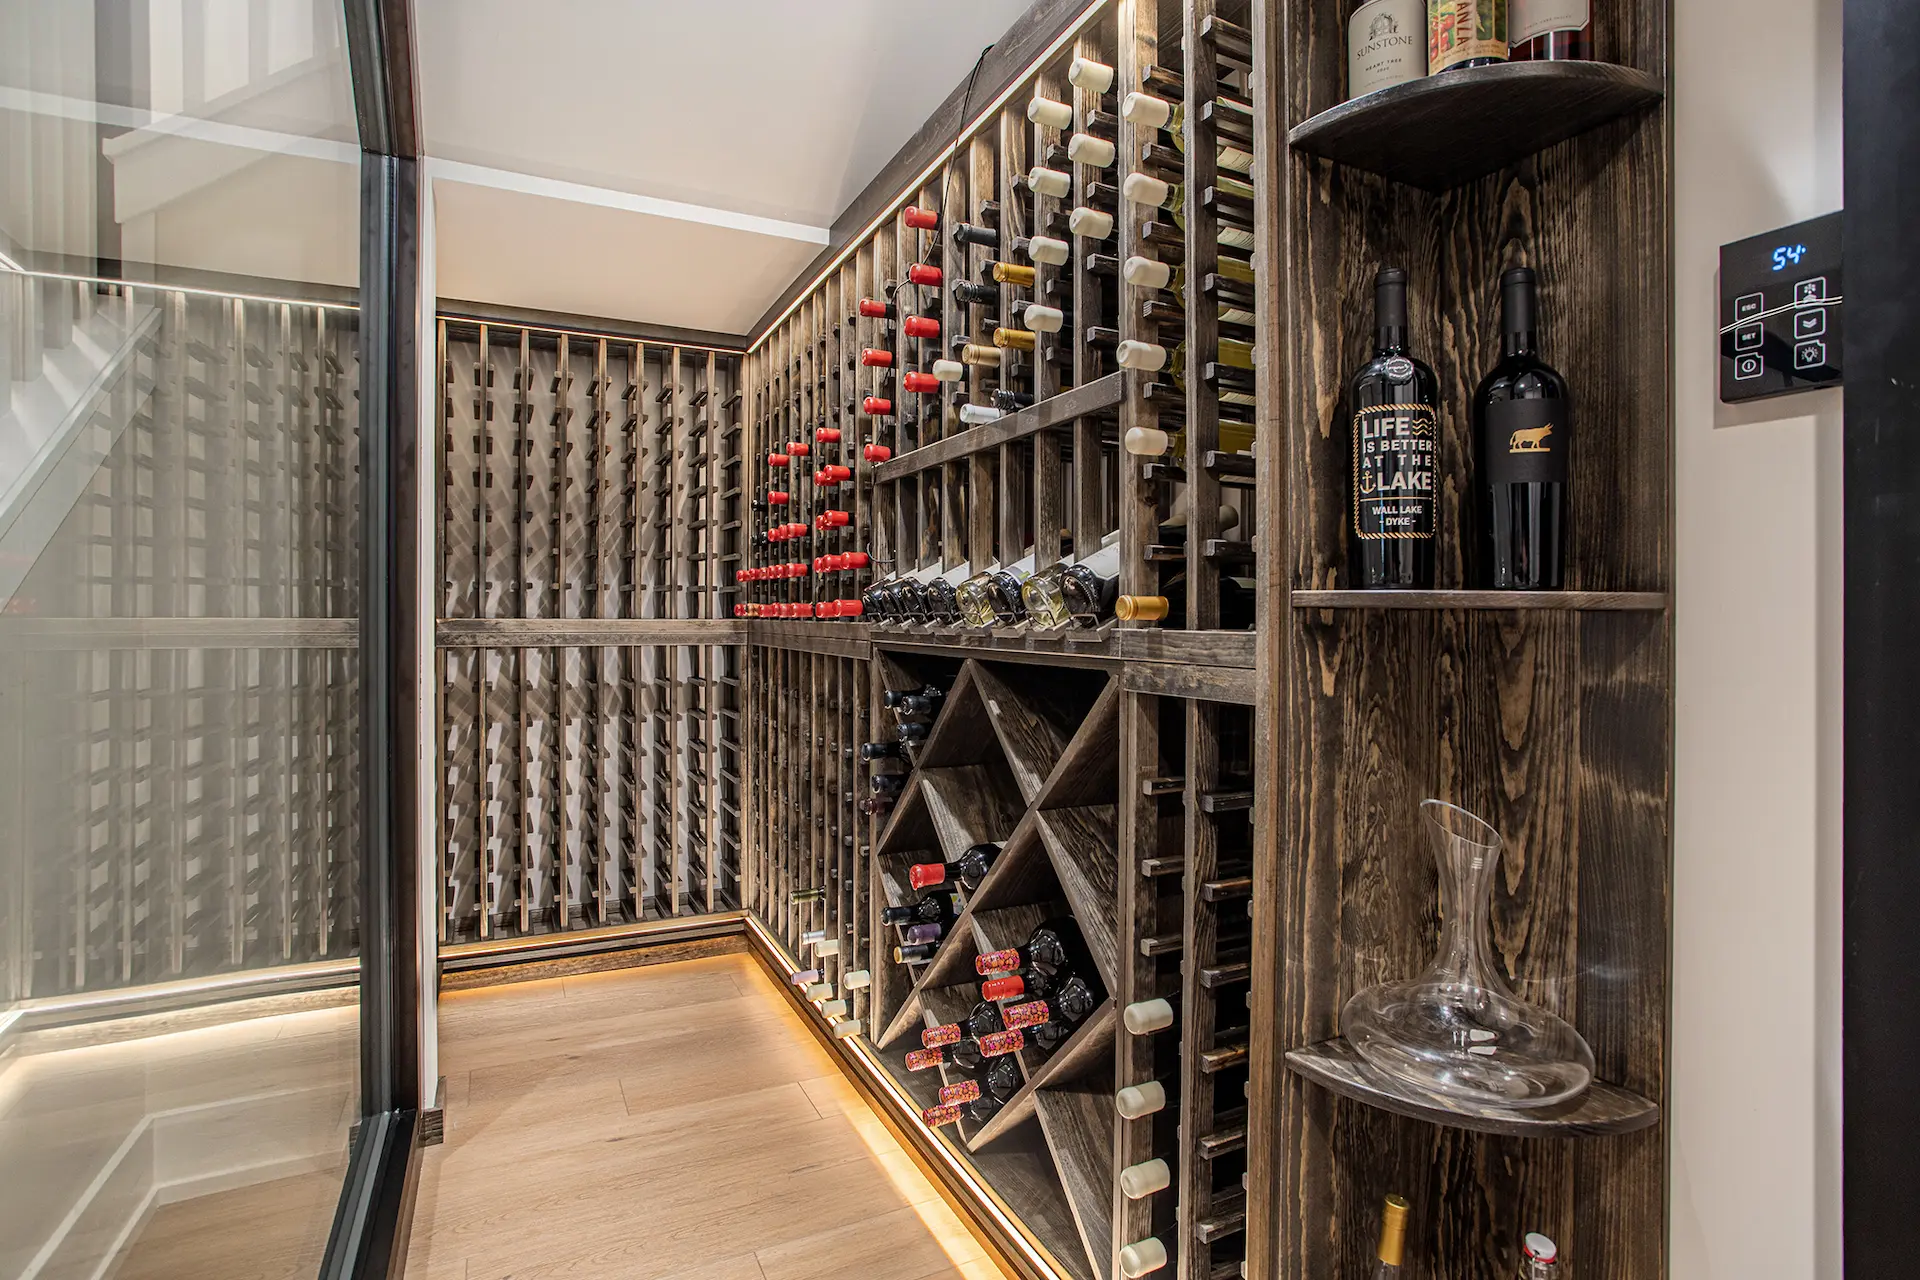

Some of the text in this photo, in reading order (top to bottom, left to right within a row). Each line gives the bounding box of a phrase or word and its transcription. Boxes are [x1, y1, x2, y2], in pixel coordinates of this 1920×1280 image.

[1356, 35, 1413, 60] SUNSTONE
[1741, 332, 1757, 341] SET
[1363, 417, 1410, 439] LIFE
[1363, 439, 1432, 453] IS BETTER
[1363, 453, 1432, 469] AT THE
[1377, 471, 1432, 491] LAKE
[1371, 505, 1423, 515] WALL LAKE
